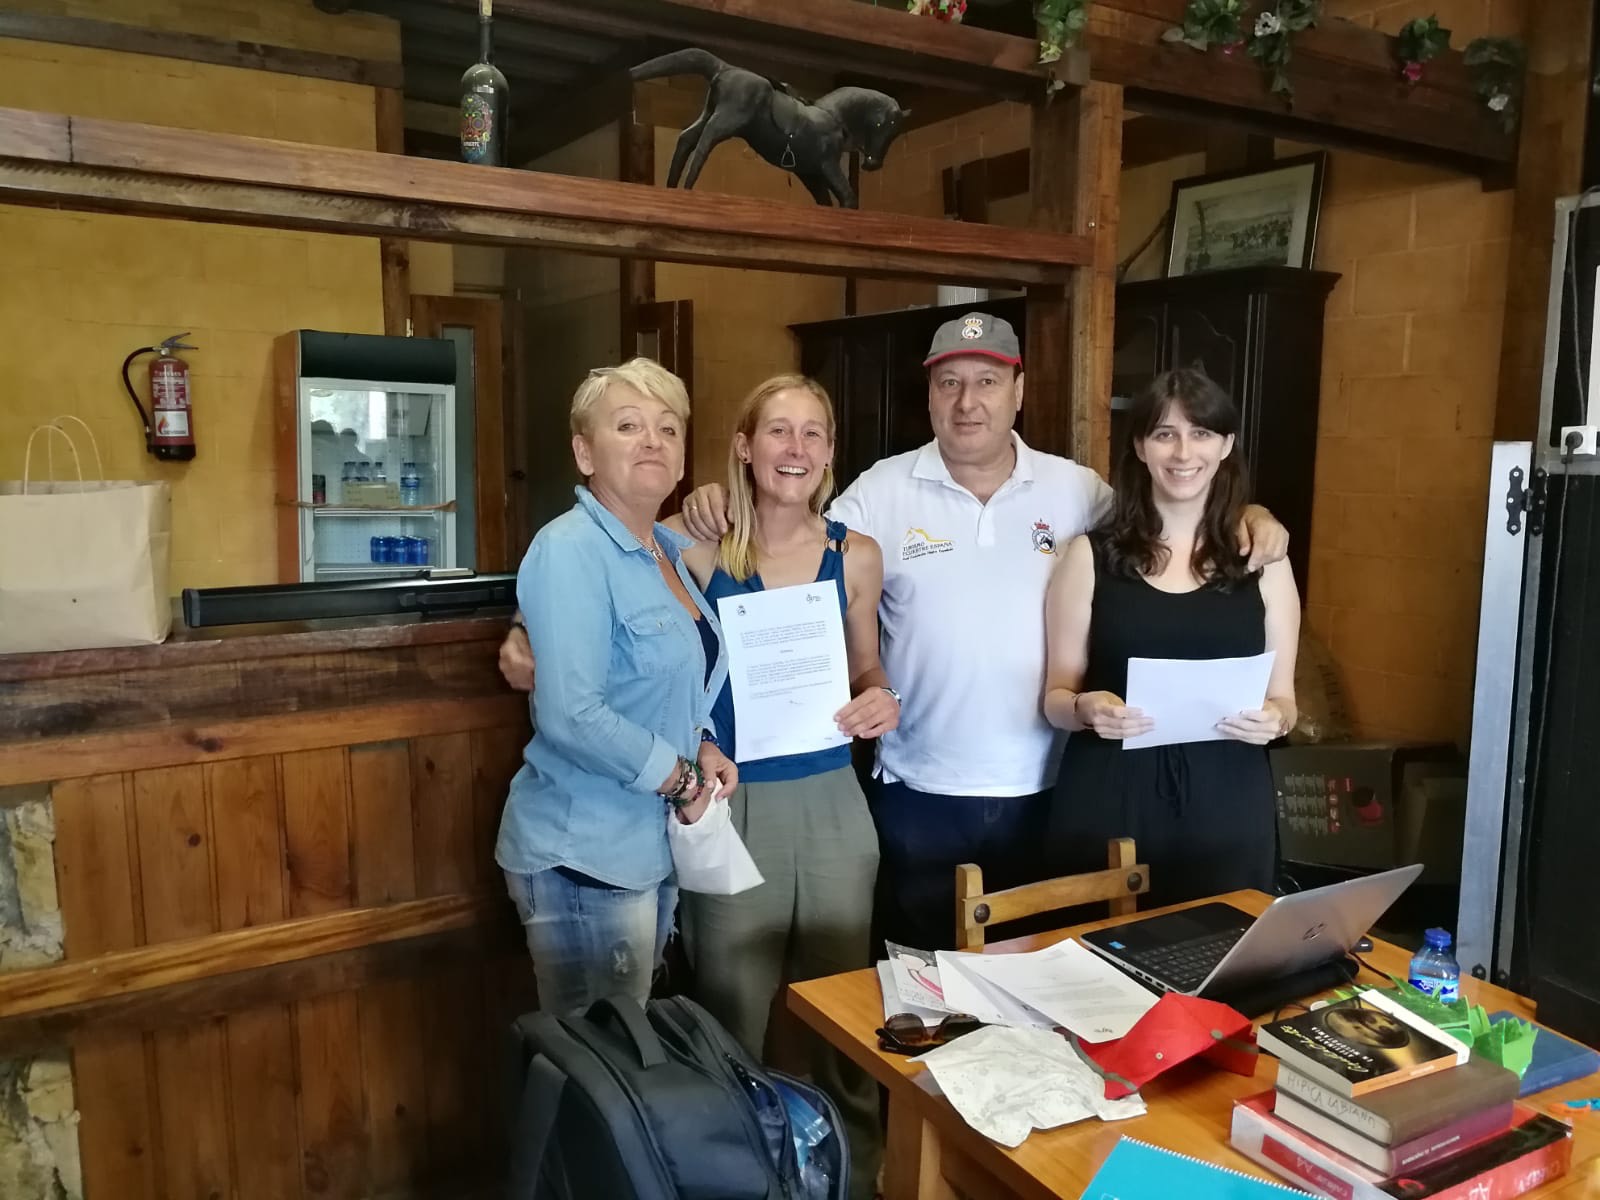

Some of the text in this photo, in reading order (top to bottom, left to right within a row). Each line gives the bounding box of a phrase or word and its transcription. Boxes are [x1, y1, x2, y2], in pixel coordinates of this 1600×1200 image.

[1311, 1026, 1374, 1063] EN MESOPOTAMIA
[1314, 1035, 1354, 1059] ASESINATO
